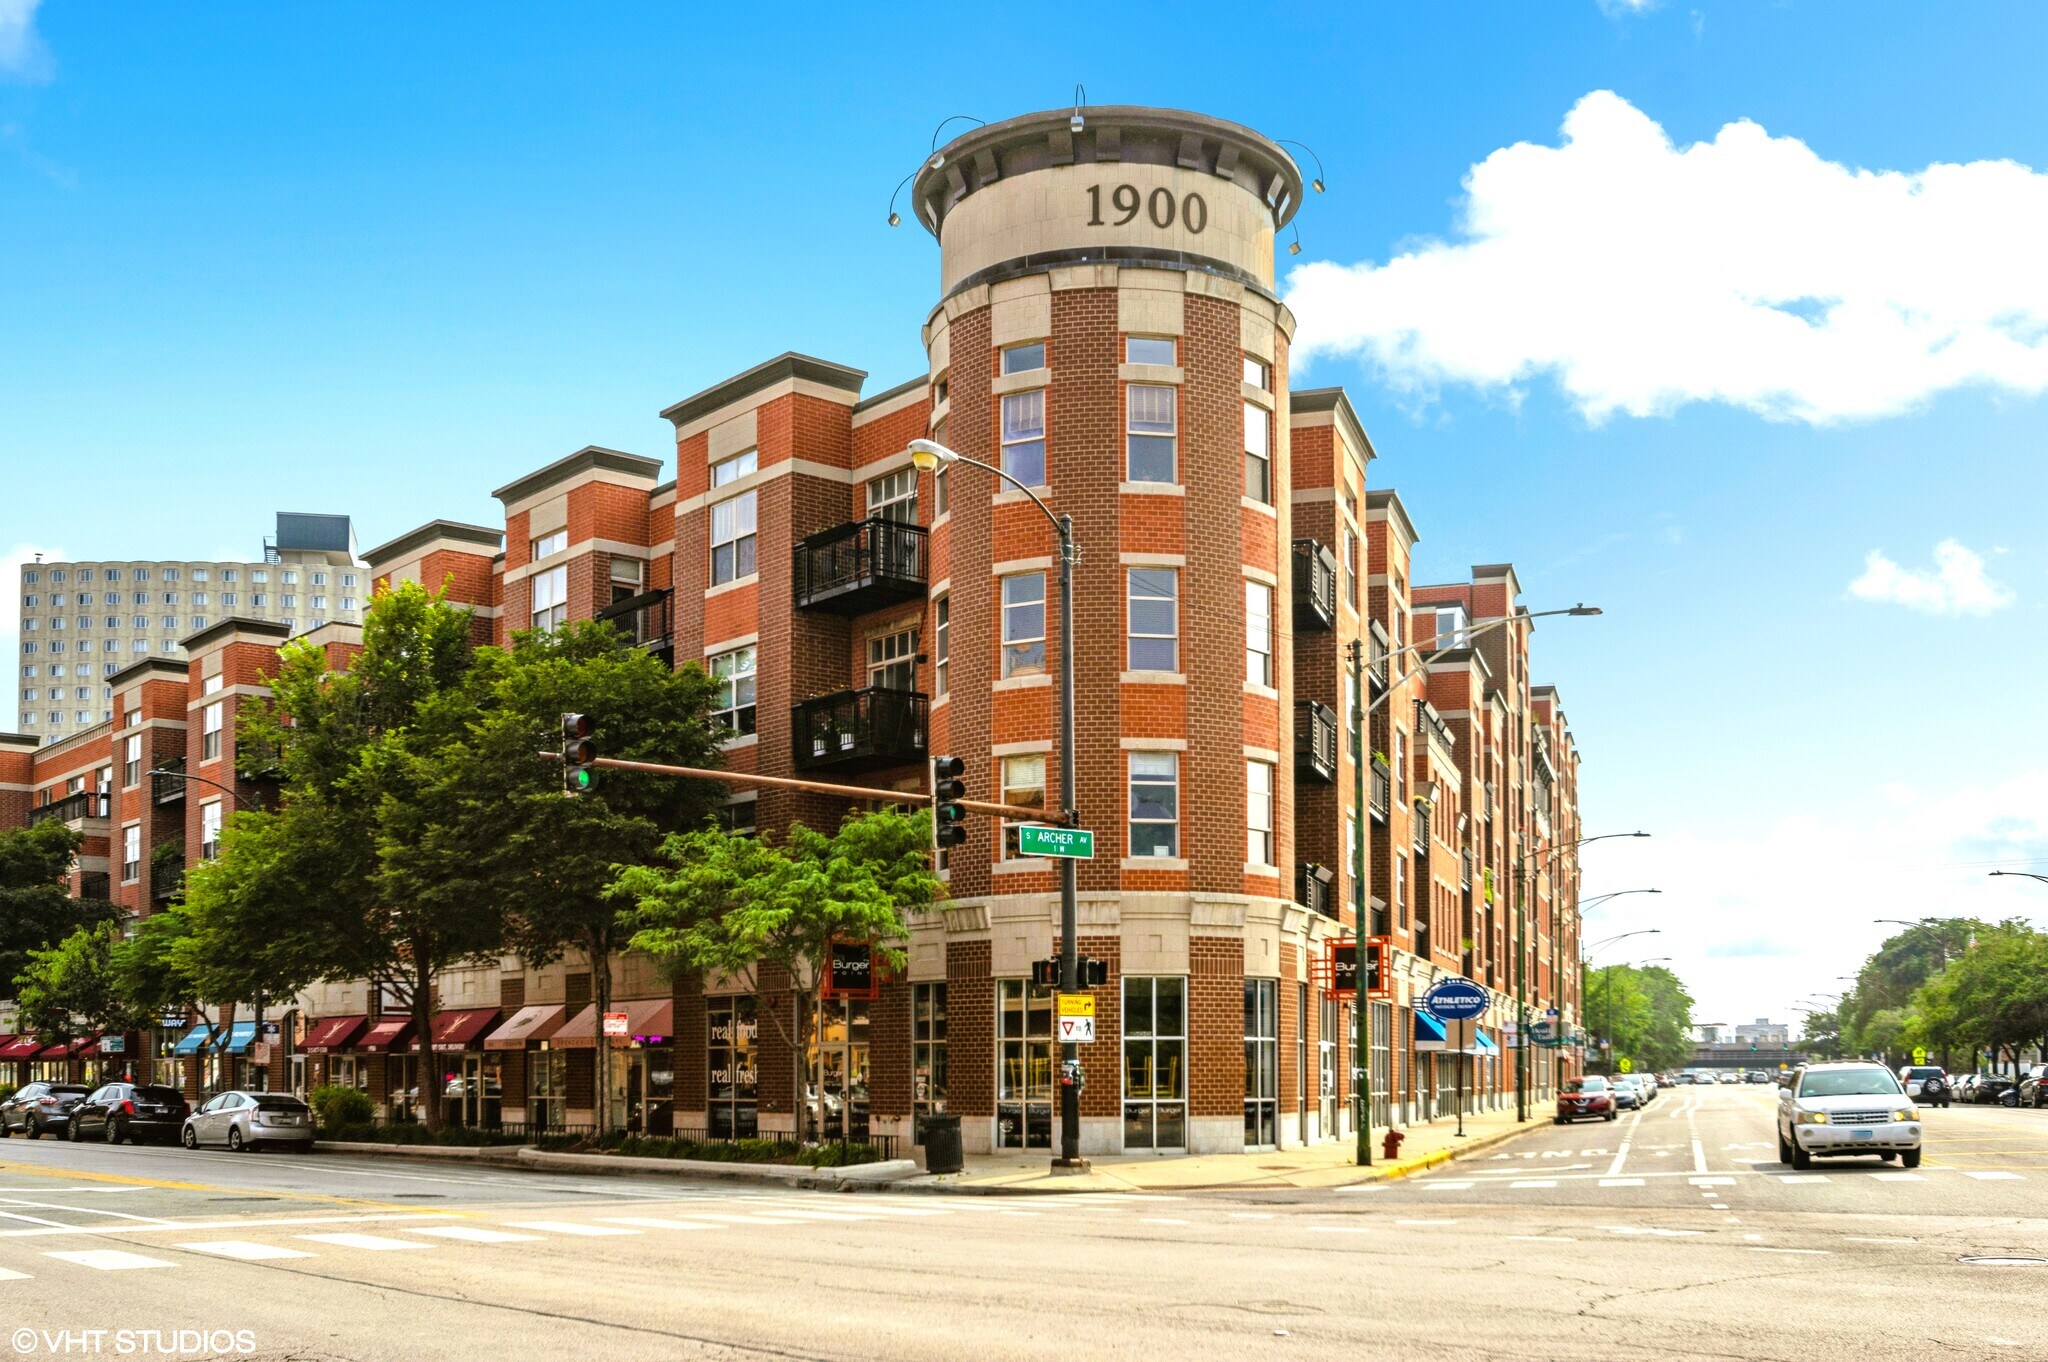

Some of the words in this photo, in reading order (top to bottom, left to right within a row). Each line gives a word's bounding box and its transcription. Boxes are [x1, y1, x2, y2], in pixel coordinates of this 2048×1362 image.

[1087, 184, 1207, 234] 1900
[1038, 832, 1073, 844] ARCHER
[833, 960, 870, 971] Burger
[1335, 962, 1379, 971] Burer
[1431, 996, 1481, 1004] ATHLETICO
[712, 1020, 732, 1039] real
[736, 1020, 757, 1039] food
[712, 1064, 731, 1083] real
